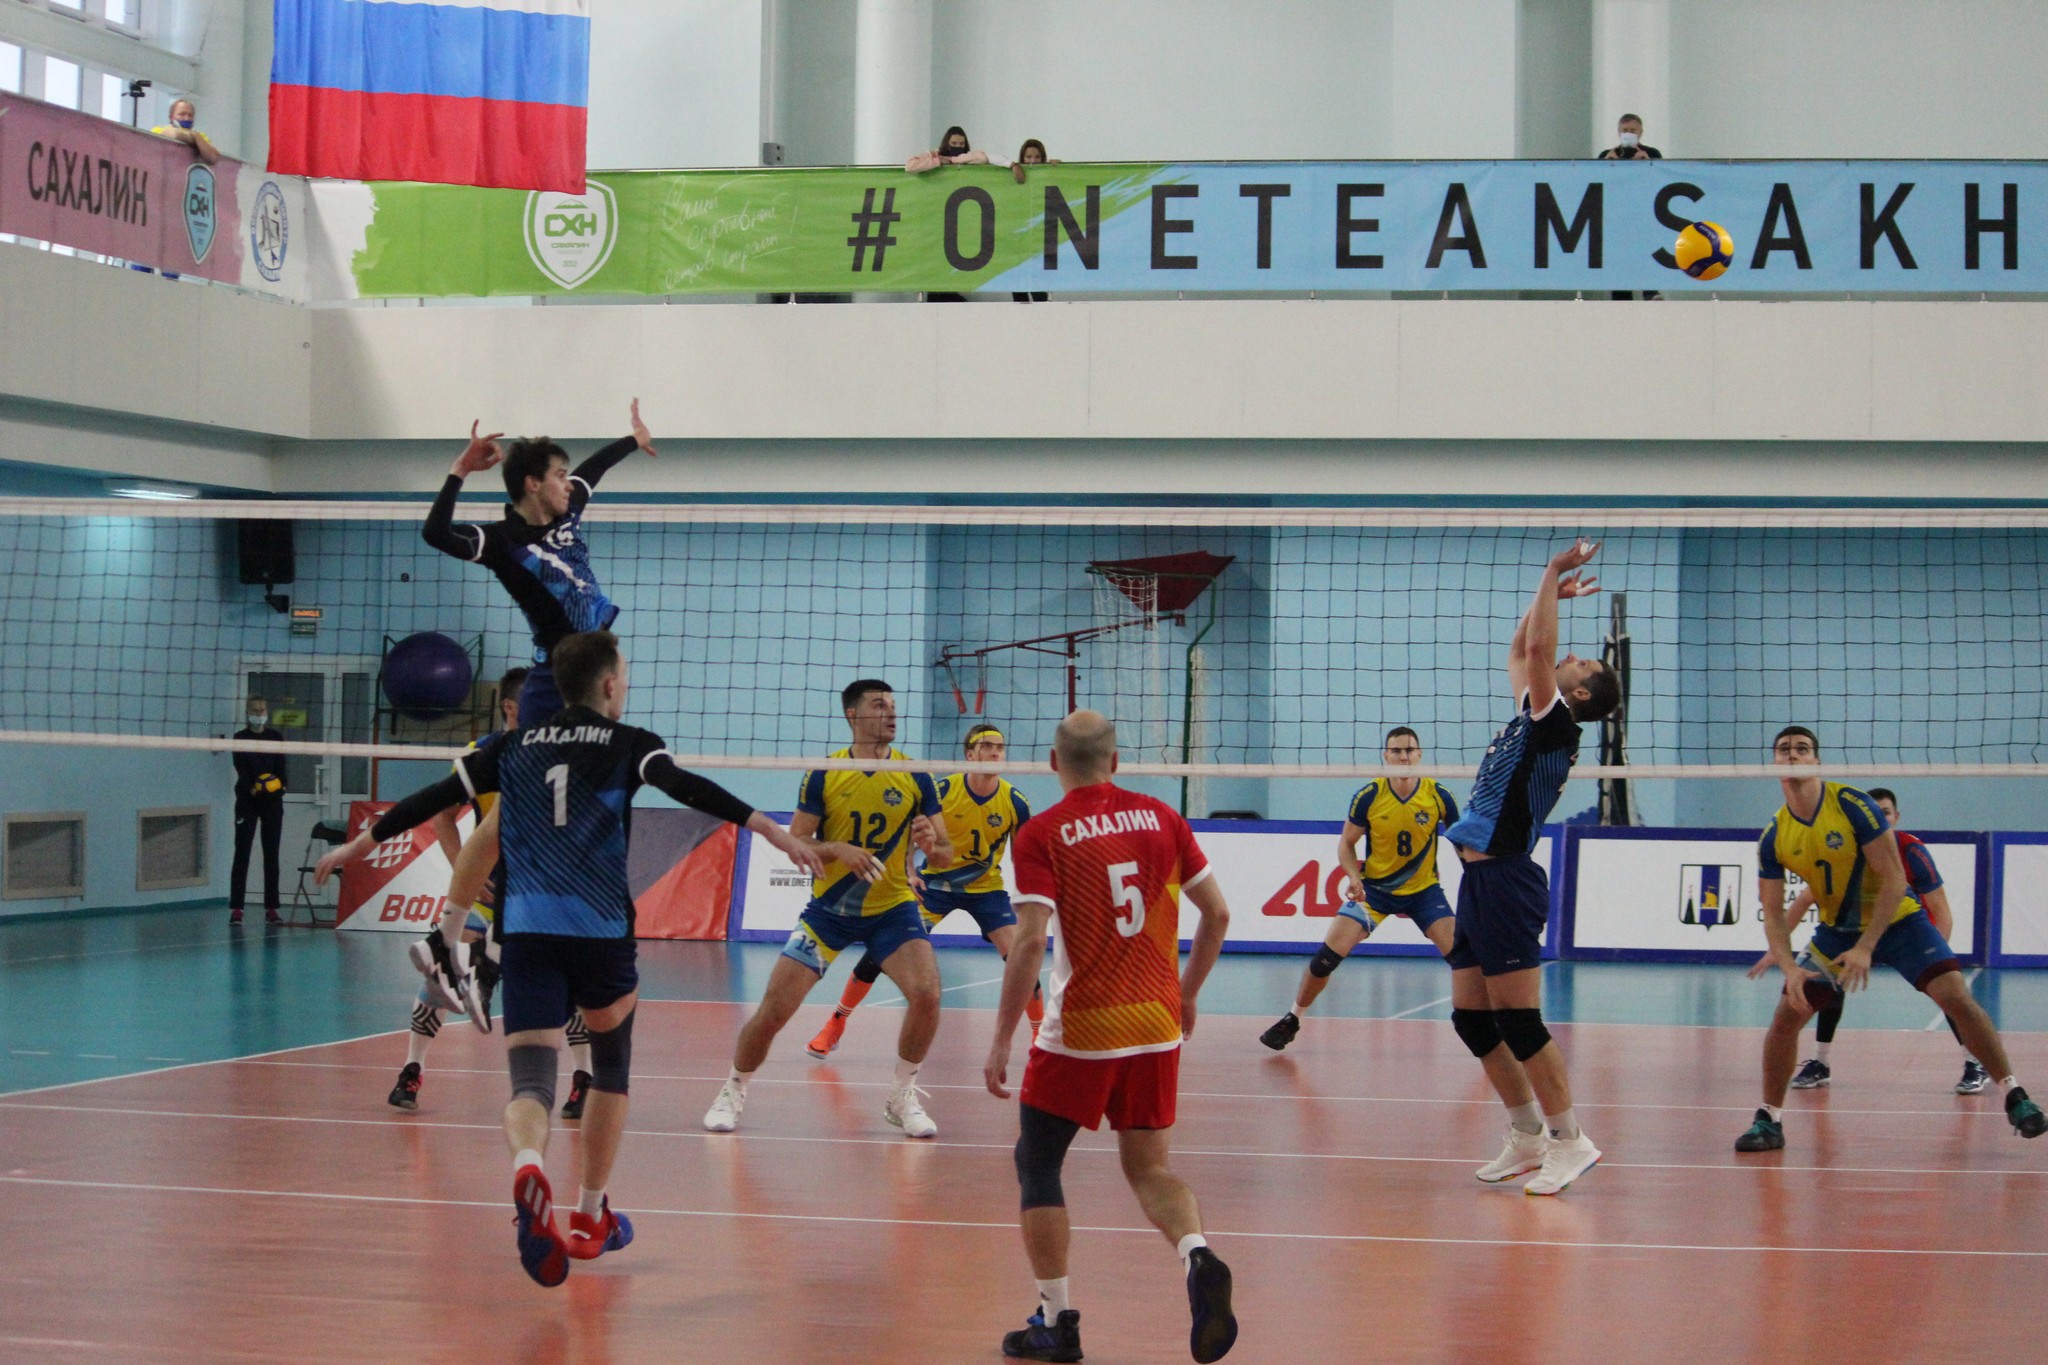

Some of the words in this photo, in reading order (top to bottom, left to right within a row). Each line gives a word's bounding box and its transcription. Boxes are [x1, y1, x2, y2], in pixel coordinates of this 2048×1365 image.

[27, 141, 148, 227] САХАЛИН
[521, 725, 614, 746] САХАЛИН
[544, 763, 569, 827] 1
[847, 810, 887, 850] 12
[969, 829, 982, 857] 1
[1060, 809, 1161, 847] САХАЛИН
[1396, 830, 1413, 857] 8
[769, 877, 813, 887] WWW.ONET
[1106, 860, 1146, 937] 5
